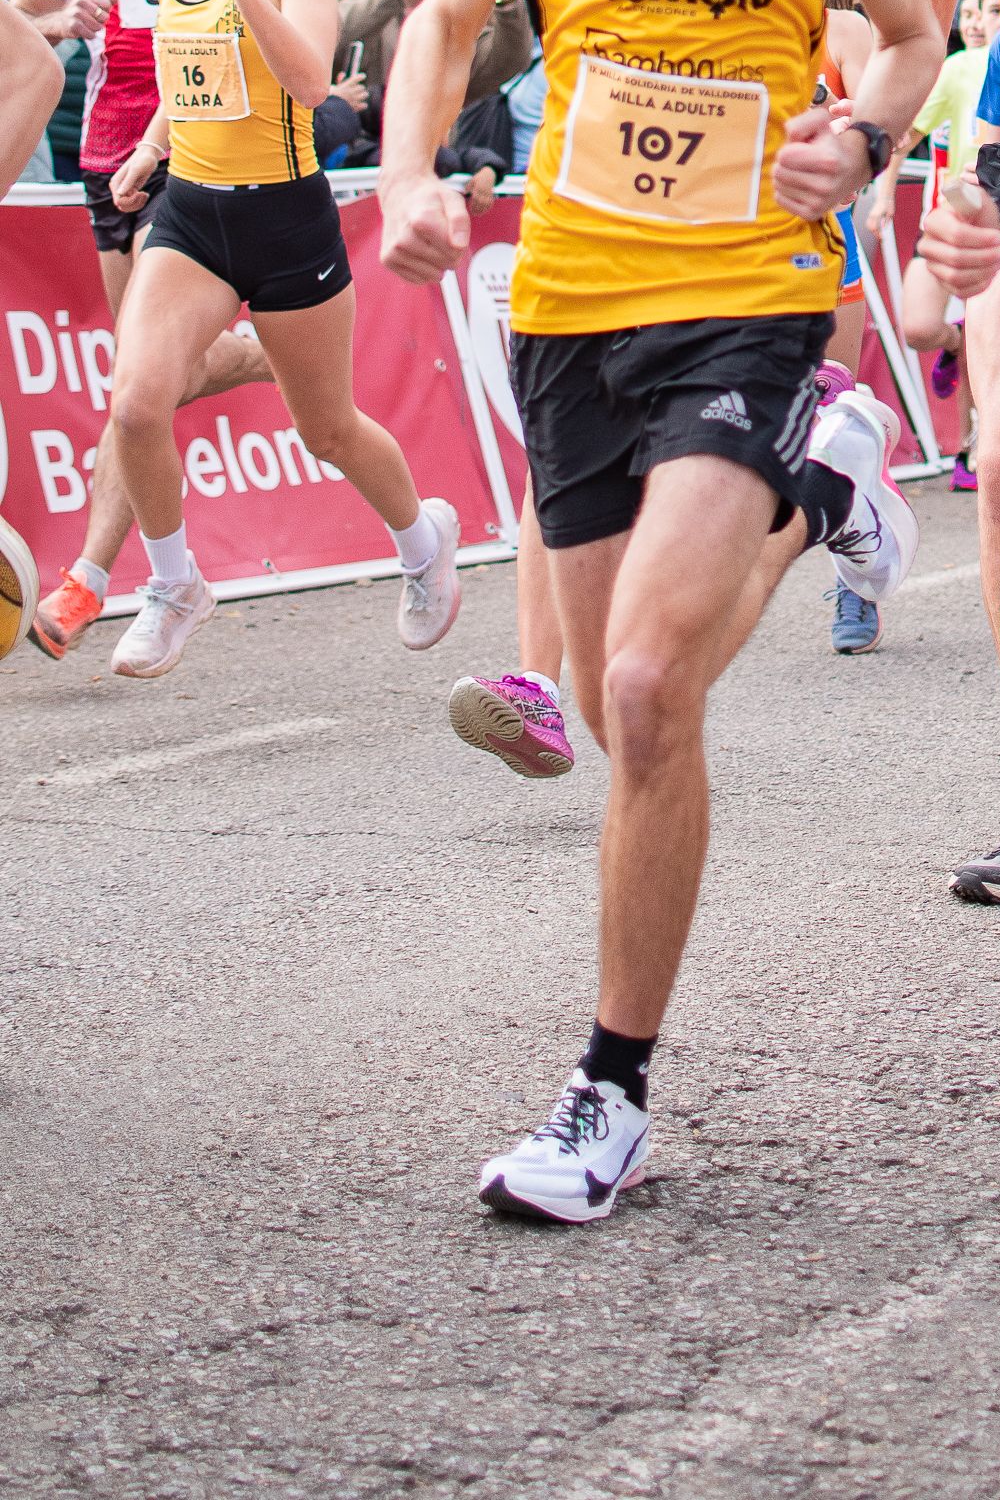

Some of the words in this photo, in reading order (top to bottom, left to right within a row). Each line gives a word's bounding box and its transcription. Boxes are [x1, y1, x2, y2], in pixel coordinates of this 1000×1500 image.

[189, 48, 218, 56] ADULTS
[182, 65, 205, 87] 16
[589, 64, 598, 73] IX
[600, 67, 622, 82] MILLA
[681, 86, 694, 95] DE
[699, 88, 761, 101] VALLDOREIX
[175, 93, 223, 107] CLARA
[609, 88, 656, 109] MILLA
[662, 101, 726, 117] ADULTS
[619, 120, 706, 166] 107
[634, 172, 678, 198] OT
[700, 406, 753, 431] adidas
